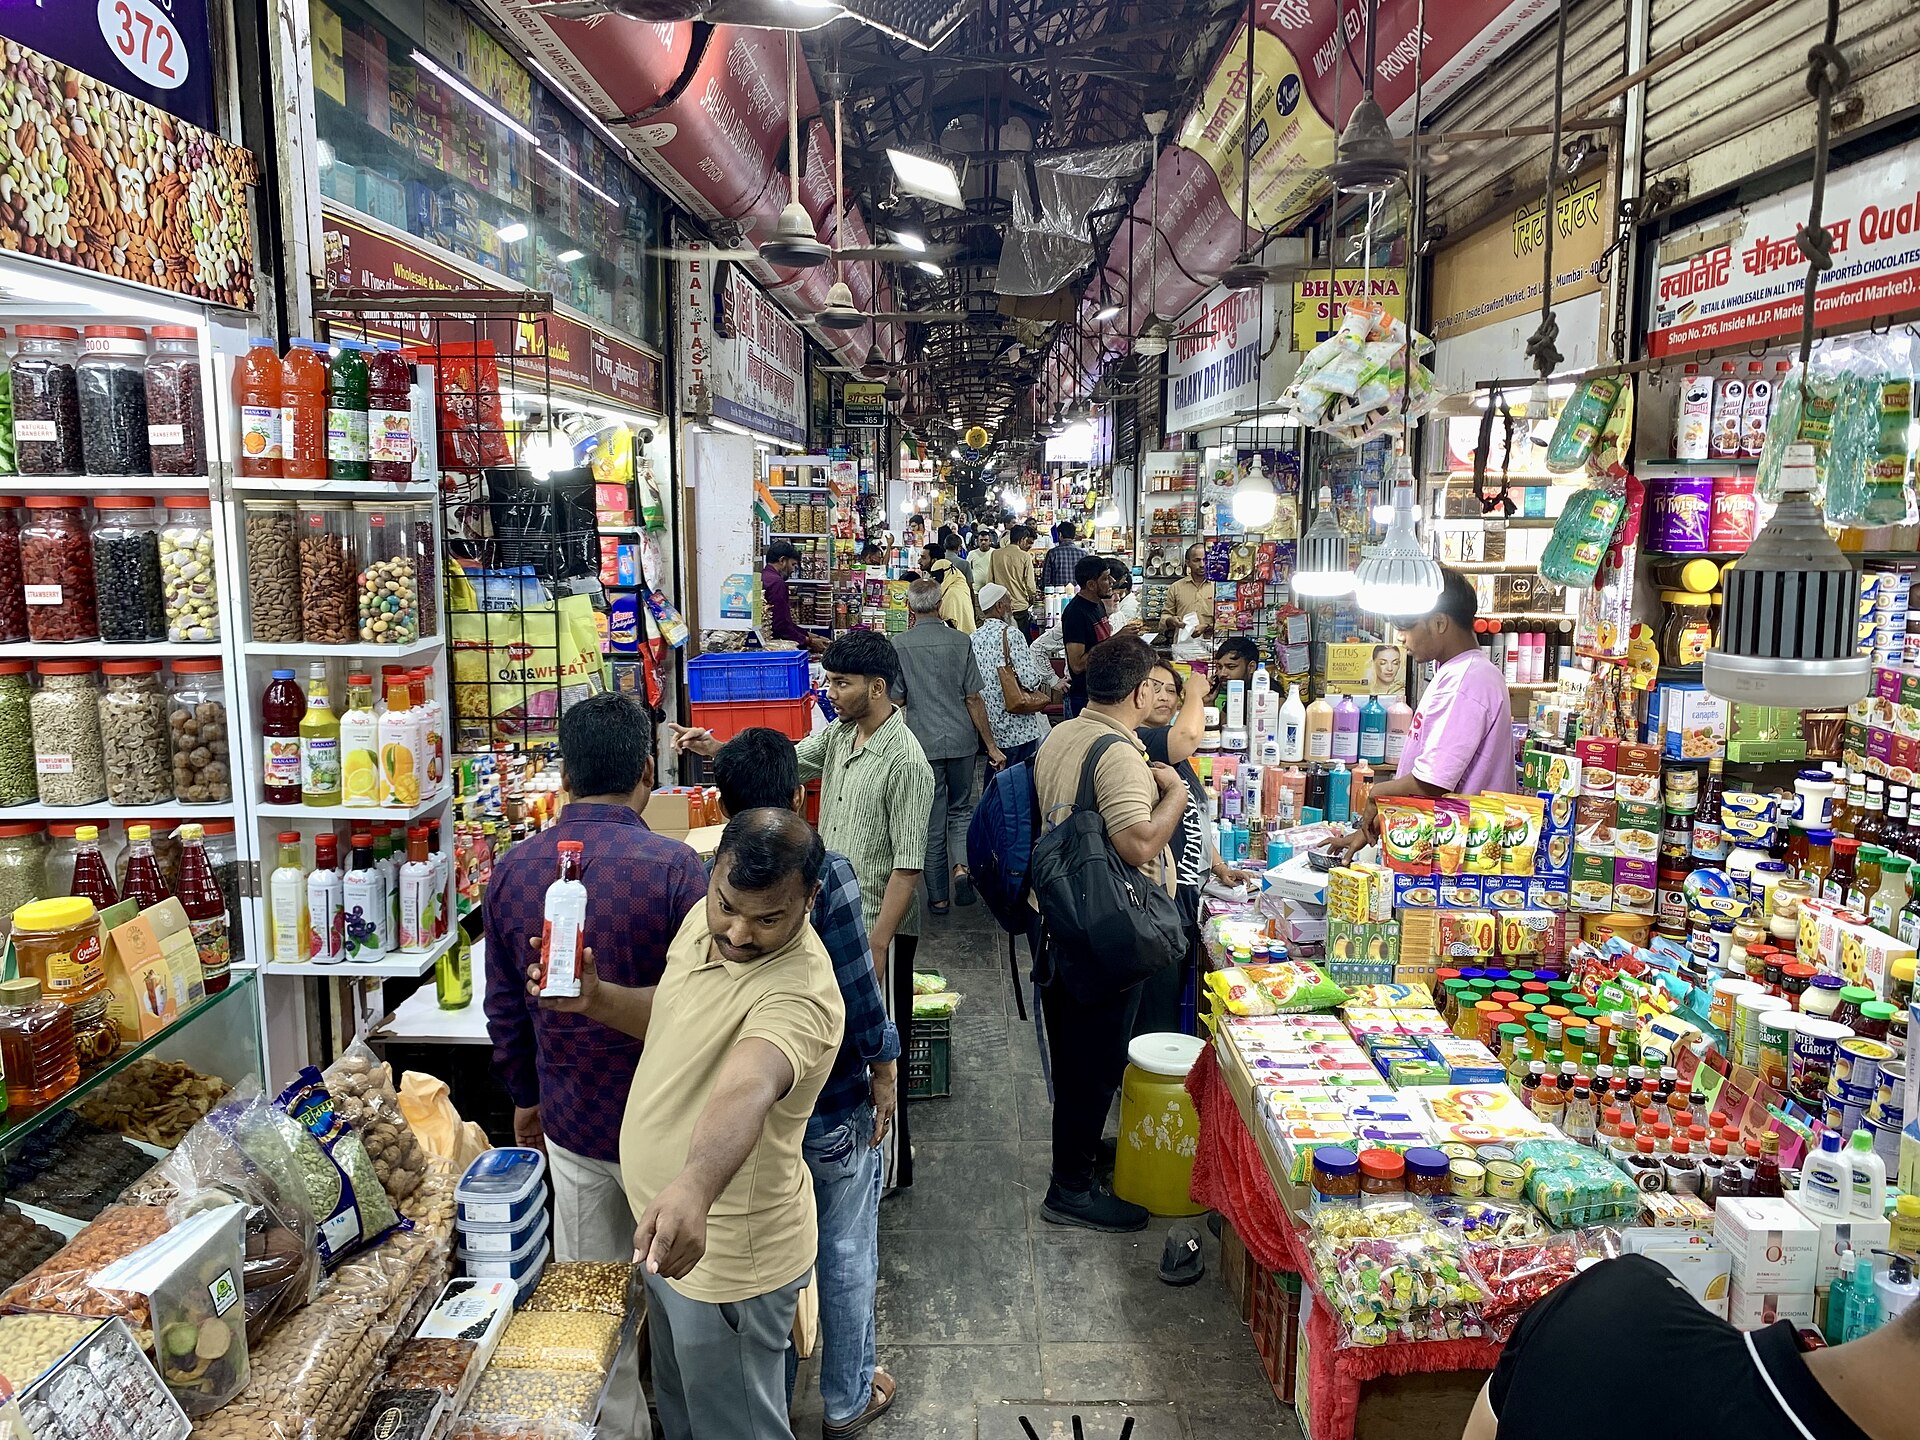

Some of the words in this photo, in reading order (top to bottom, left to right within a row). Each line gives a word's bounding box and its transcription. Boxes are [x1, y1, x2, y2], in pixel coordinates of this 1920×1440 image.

[507, 5, 536, 36] INSIDE
[115, 1, 175, 79] 372
[1376, 24, 1434, 82] PROVISION
[696, 156, 726, 184] PROVISION
[1556, 176, 1602, 239] सेंटर
[361, 269, 370, 288] All
[369, 270, 386, 290] Types
[392, 261, 428, 288] Wholesale
[428, 276, 435, 291] &
[1700, 298, 1721, 315] RETAIL
[1720, 297, 1727, 310] &
[1726, 287, 1765, 310] WHOLESALE
[1764, 286, 1773, 299] IN
[1772, 282, 1786, 297] ALL
[1786, 277, 1806, 295] TYPE
[1820, 262, 1863, 285] IMPORTED
[1863, 250, 1920, 274] CHOCOLATES
[1301, 279, 1400, 297] BHAVANA
[1466, 307, 1481, 321] Inside
[1481, 295, 1505, 315] Crawford
[1504, 288, 1526, 307] Market,
[1527, 284, 1537, 298] 3rd
[1538, 280, 1555, 295] Lae,
[1556, 266, 1583, 286] Mumbai
[1668, 329, 1688, 345] Shop
[1687, 326, 1701, 343] No.
[1701, 322, 1719, 340] 276,
[1719, 317, 1746, 334] Inside
[1746, 310, 1773, 328] M.J.P.
[1773, 302, 1804, 323] Marke
[1865, 276, 1916, 302] Market),
[1174, 370, 1203, 411] GALAXY
[1203, 359, 1222, 400] DRY
[1223, 339, 1260, 392] FRUITS
[1721, 407, 1740, 416] SAUCE
[1723, 400, 1741, 410] CHILLI
[1748, 407, 1766, 416] SAUCE
[1749, 400, 1767, 410] CHILLI
[864, 416, 878, 424] 365
[17, 430, 54, 438] CRANBERRY
[1667, 494, 1709, 514] Twister
[27, 590, 60, 598] STRAWBERRY
[1332, 648, 1359, 659] LOTUS
[498, 662, 585, 681] OAT&WHEAT
[1588, 744, 1605, 752] Shan
[1629, 750, 1647, 758] Shan
[38, 757, 70, 765] SUNFLOWER
[1392, 830, 1419, 847] TANG
[1587, 857, 1603, 865] Shan
[1626, 861, 1644, 869] Shan
[1715, 901, 1729, 909] Kraft
[1692, 933, 1712, 943] nute
[1800, 1042, 1832, 1056] CLARK'S
[1811, 1171, 1835, 1184] Cetaphil
